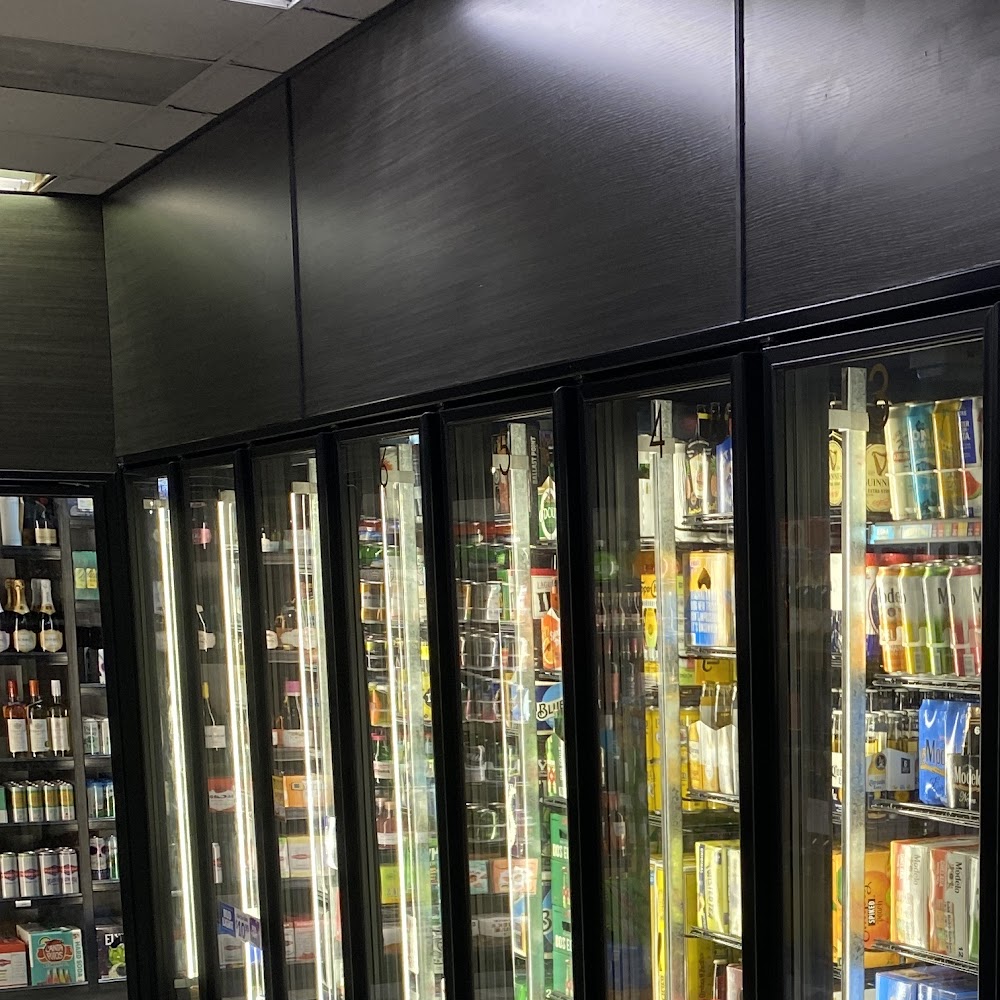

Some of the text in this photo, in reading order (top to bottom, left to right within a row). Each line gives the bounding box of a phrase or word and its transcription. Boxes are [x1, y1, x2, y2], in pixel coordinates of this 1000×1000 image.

[650, 402, 665, 458] 4
[530, 435, 539, 485] BALLAST POINT
[954, 861, 964, 894] Modelo
